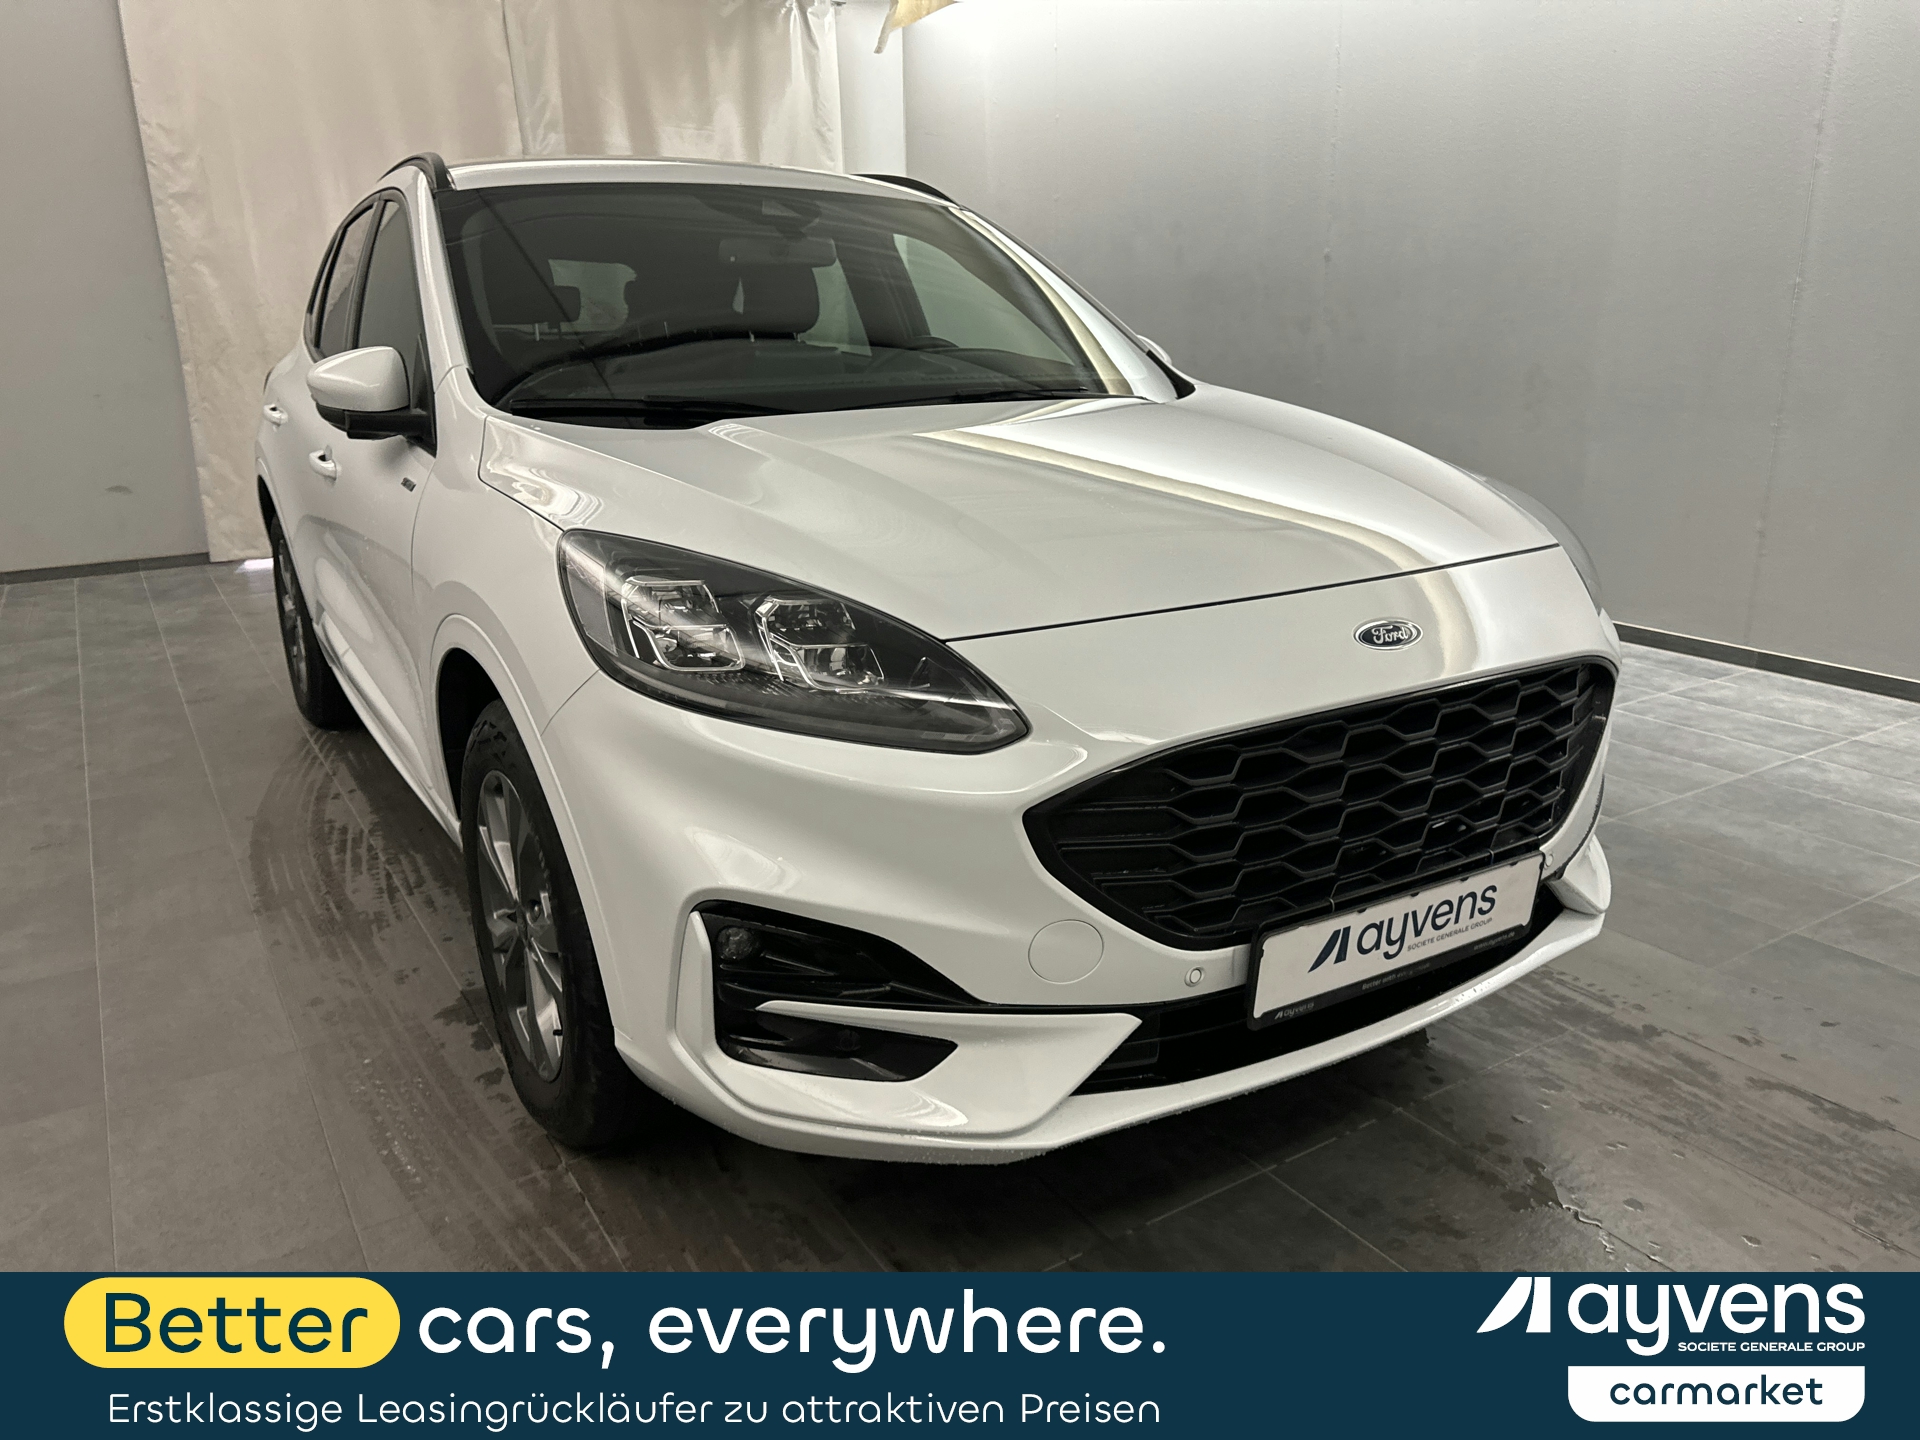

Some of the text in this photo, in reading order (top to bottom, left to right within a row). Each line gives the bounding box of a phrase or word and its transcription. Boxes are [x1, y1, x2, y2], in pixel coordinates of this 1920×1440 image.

[1371, 625, 1409, 644] Ford
[1357, 885, 1497, 960] ayvens
[1407, 917, 1493, 952] SOCIETE GENERALE GROUP
